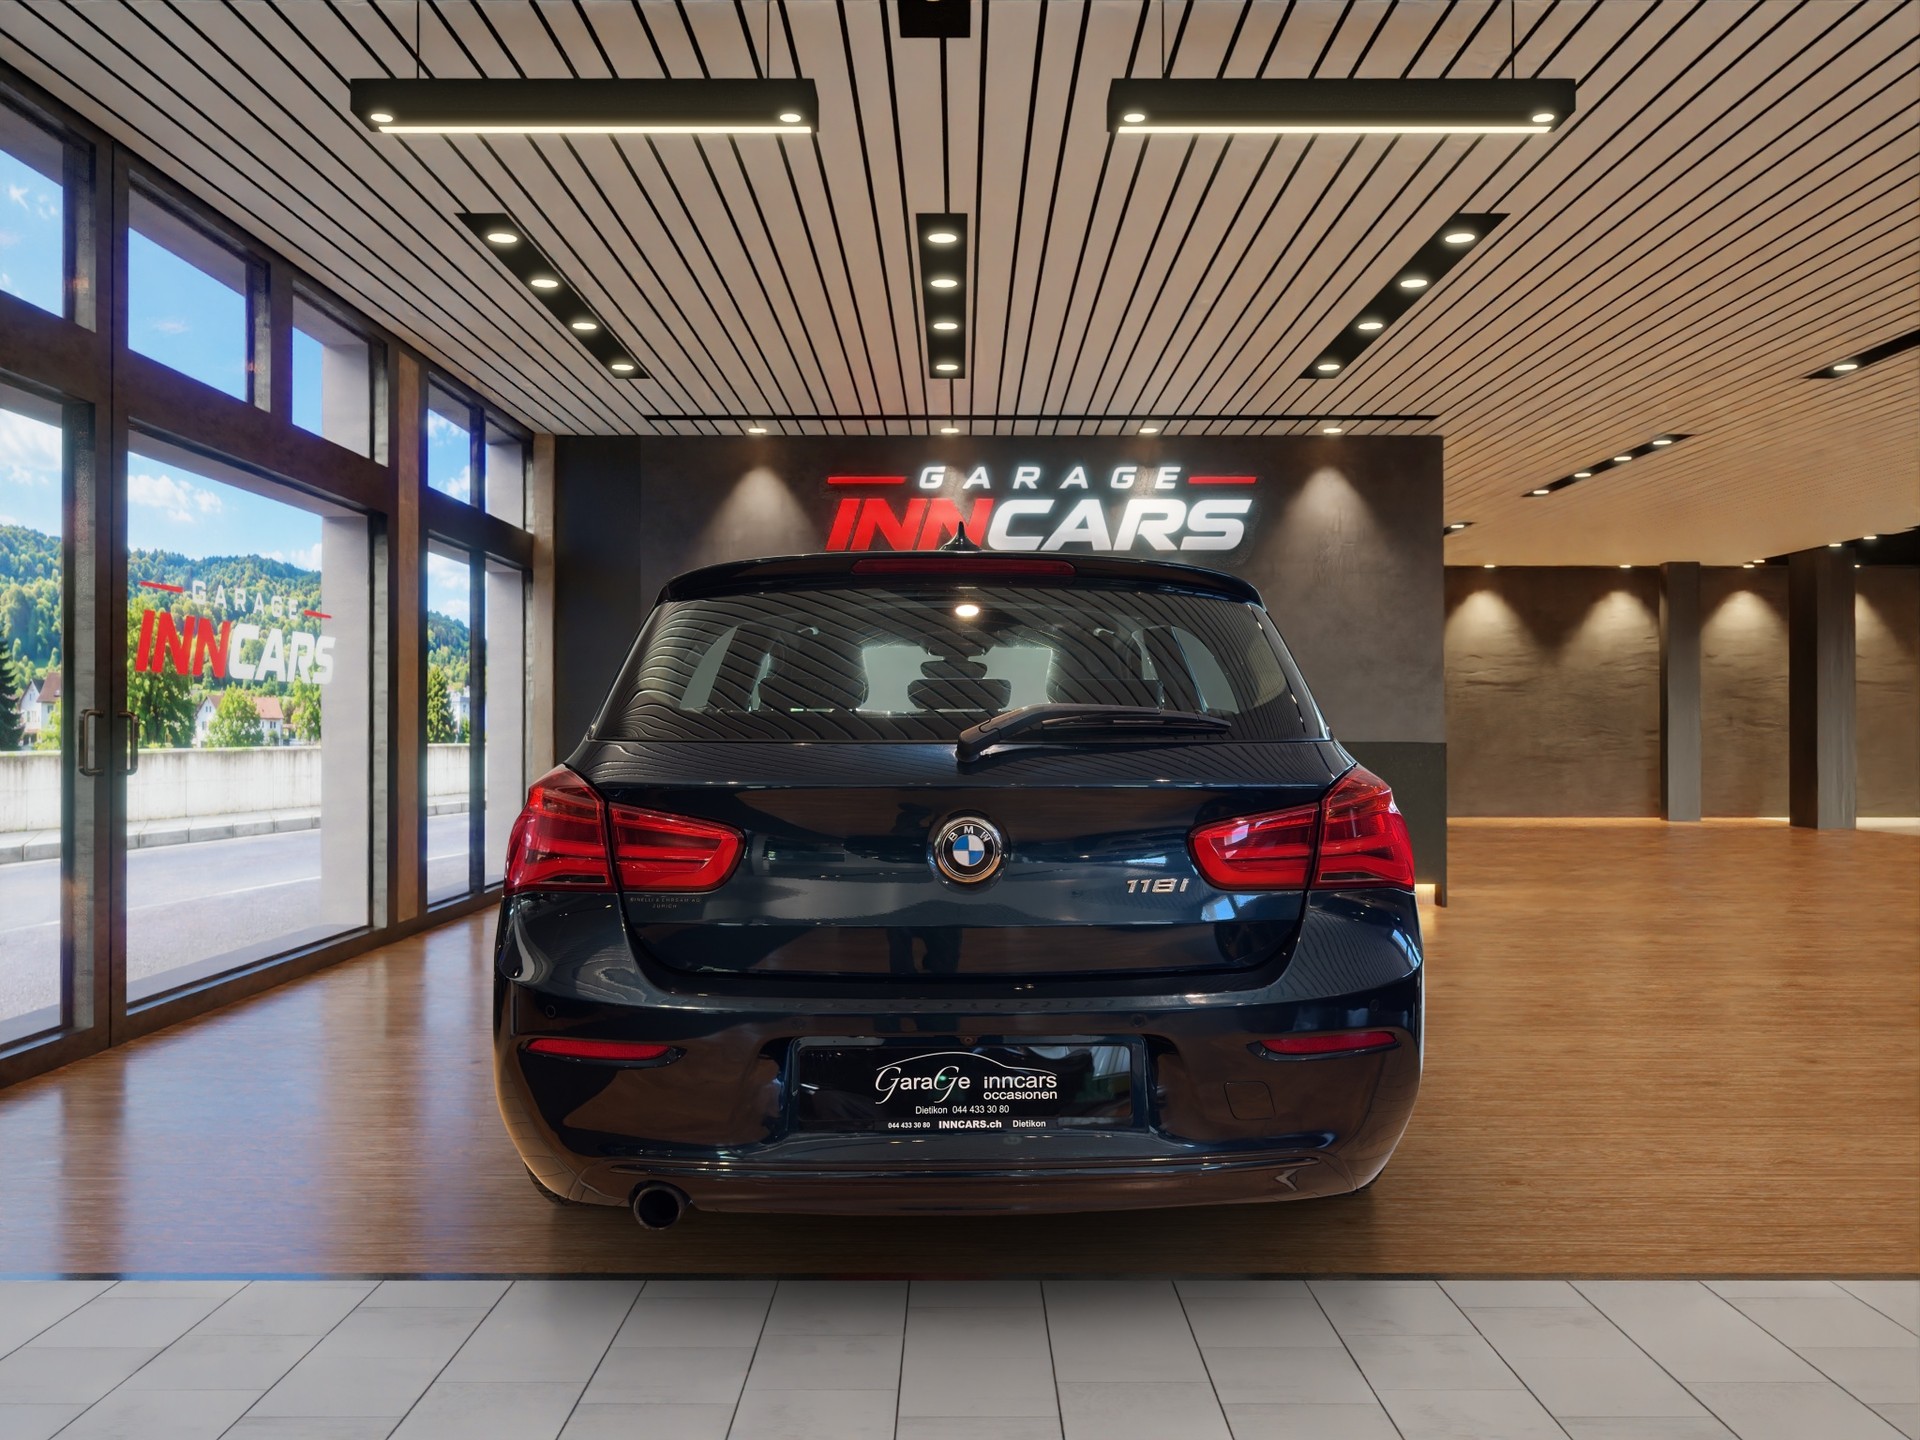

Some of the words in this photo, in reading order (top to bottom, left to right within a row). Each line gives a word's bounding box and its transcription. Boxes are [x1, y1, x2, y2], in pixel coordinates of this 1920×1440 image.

[918, 465, 1182, 490] GARAGE
[825, 497, 1253, 552] INNCARS
[191, 579, 299, 620] GARAGE
[134, 608, 337, 685] INNCARS
[947, 825, 991, 842] BMW
[983, 1074, 1058, 1090] inncars
[983, 1090, 1058, 1100] occasionen
[915, 1105, 948, 1115] Dietikon
[952, 1105, 967, 1114] 044
[969, 1104, 985, 1114] 433
[986, 1104, 997, 1114] 30
[998, 1104, 1010, 1114] 80
[887, 1121, 900, 1129] 044
[900, 1121, 913, 1129] 433
[913, 1121, 922, 1129] 30
[922, 1121, 931, 1129] 80
[938, 1120, 1002, 1129] INNCARS.ch
[1012, 1119, 1047, 1128] Dietikon
